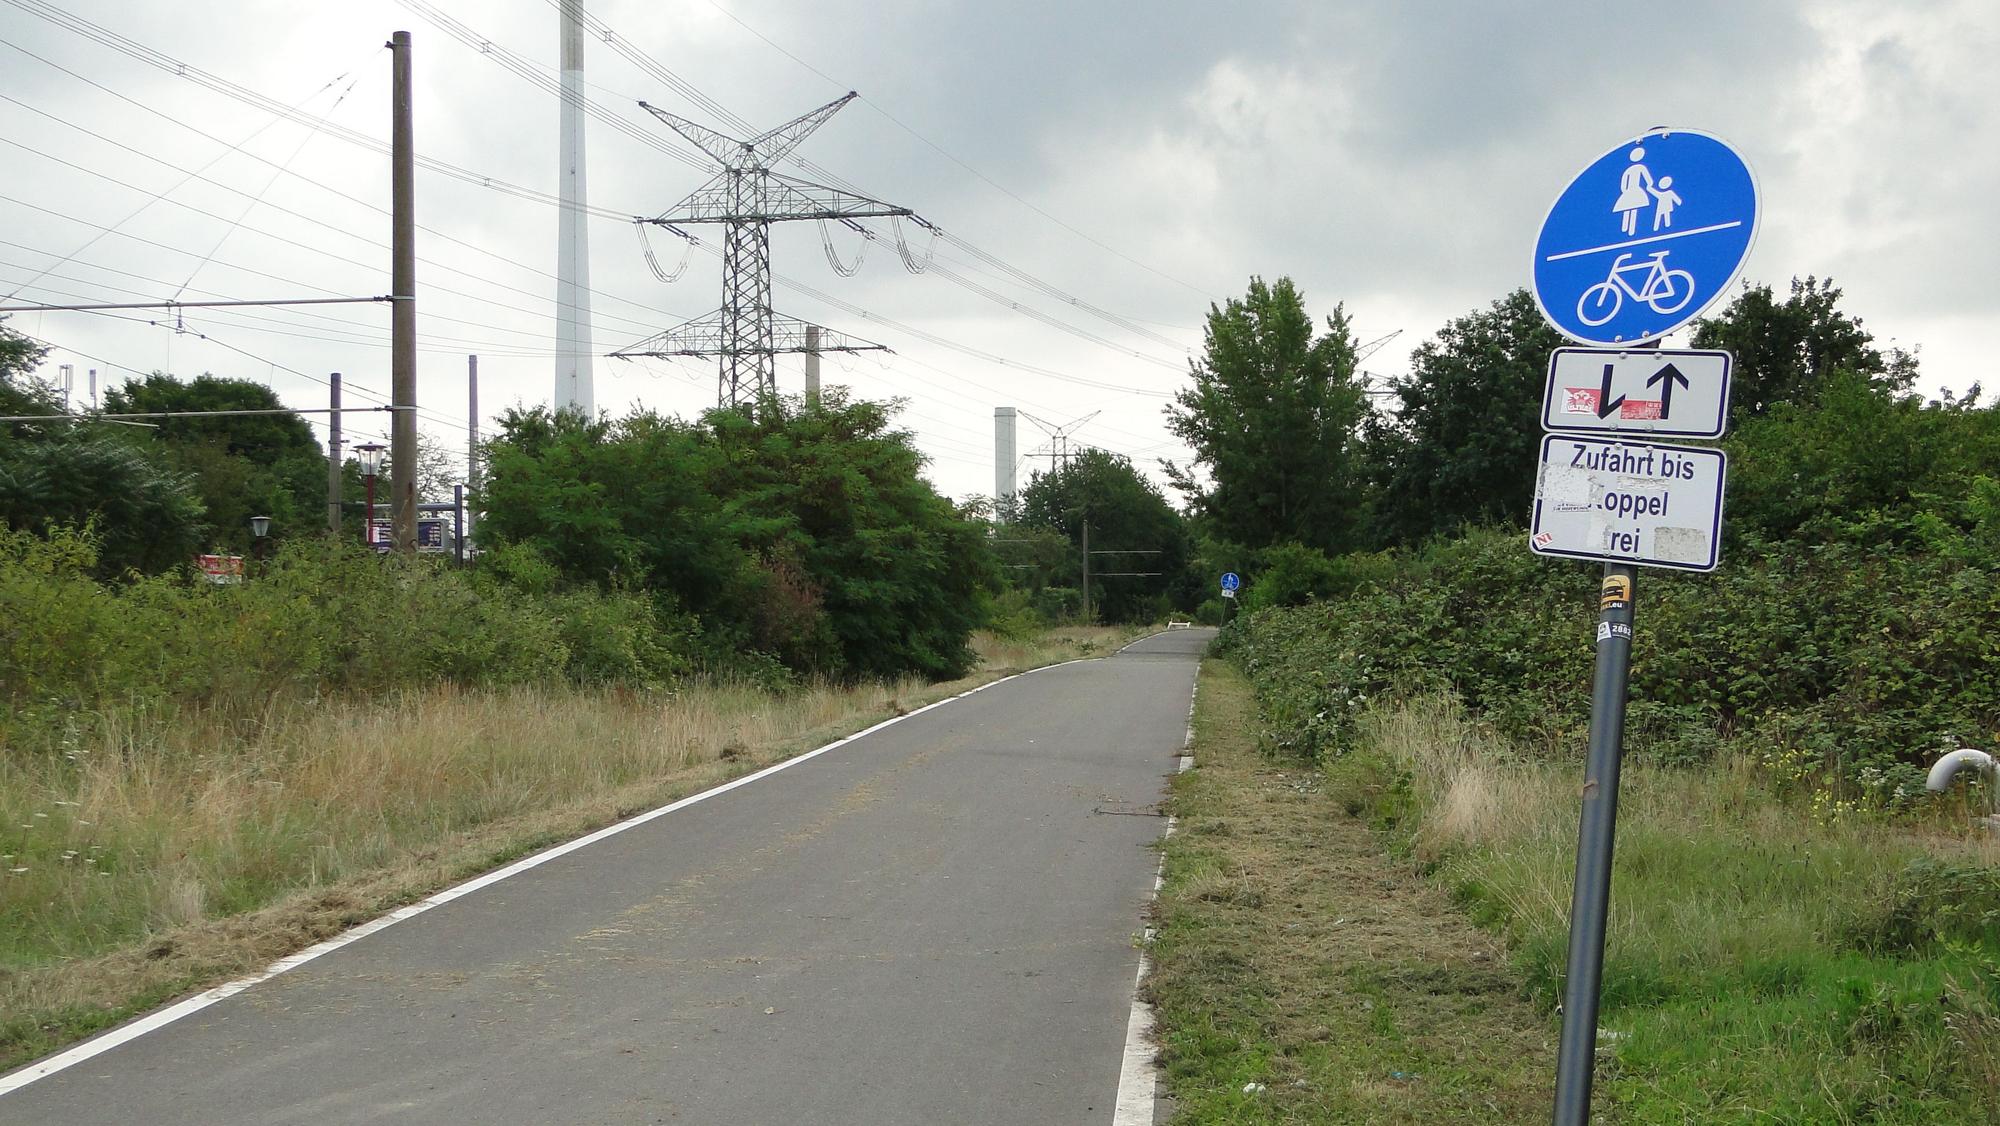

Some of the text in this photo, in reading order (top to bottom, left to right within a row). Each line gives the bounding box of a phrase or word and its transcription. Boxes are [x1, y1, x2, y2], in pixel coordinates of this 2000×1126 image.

[1570, 444, 1695, 480] Zufahrt bis
[1588, 485, 1669, 520] oppel
[1603, 526, 1641, 553] rei
